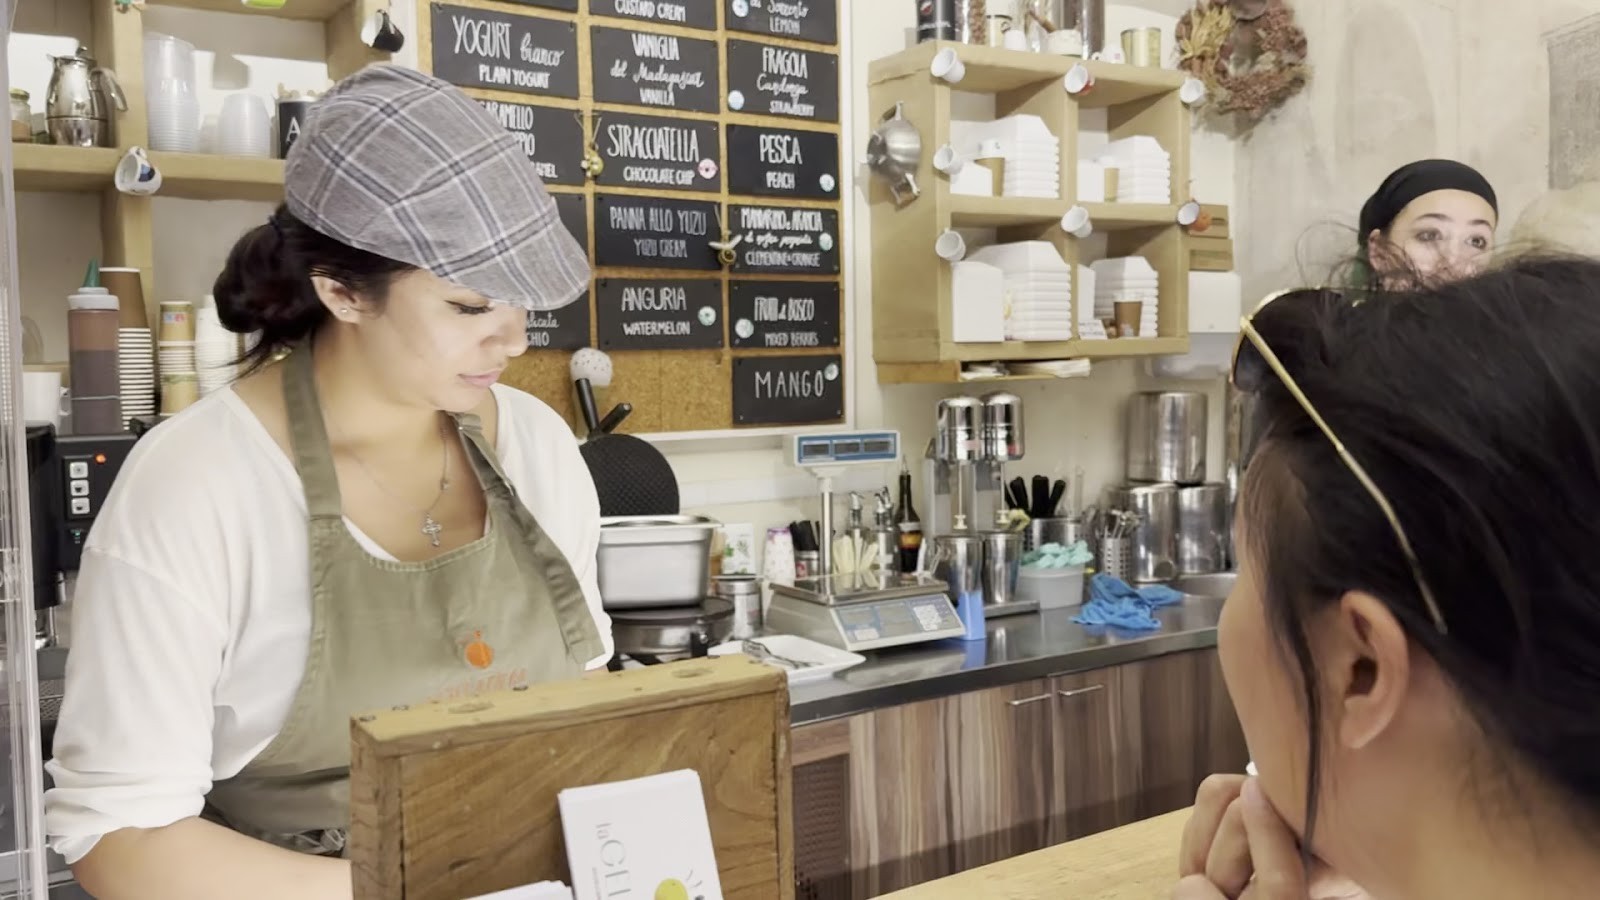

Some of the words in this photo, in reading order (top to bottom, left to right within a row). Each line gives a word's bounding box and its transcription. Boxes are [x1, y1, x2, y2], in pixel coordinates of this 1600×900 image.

[657, 3, 686, 22] CREAM
[769, 17, 801, 35] LEMON
[452, 15, 512, 60] YOGURT
[520, 32, 565, 67] bianco
[632, 33, 680, 61] VANIGLIA
[762, 47, 808, 79] FRAGOLA
[479, 64, 511, 84] PLAIN
[513, 67, 550, 89] YOGURT
[640, 88, 675, 107] VANILLA
[607, 124, 700, 163] STRACCIATELLA
[759, 134, 803, 165] PESCA
[623, 165, 675, 185] CHOCOLATE
[675, 169, 696, 186] CHIP
[766, 170, 796, 190] PEACH
[610, 205, 647, 231] PANNA
[649, 207, 674, 233] ALLO
[677, 209, 707, 236] YUZU
[660, 239, 688, 259] CREAM
[621, 286, 687, 312] ANGURIA
[787, 297, 816, 322] BOSCO
[623, 320, 691, 336] WATERMELON
[764, 332, 789, 348] MIXED
[754, 369, 824, 399] MANGO
